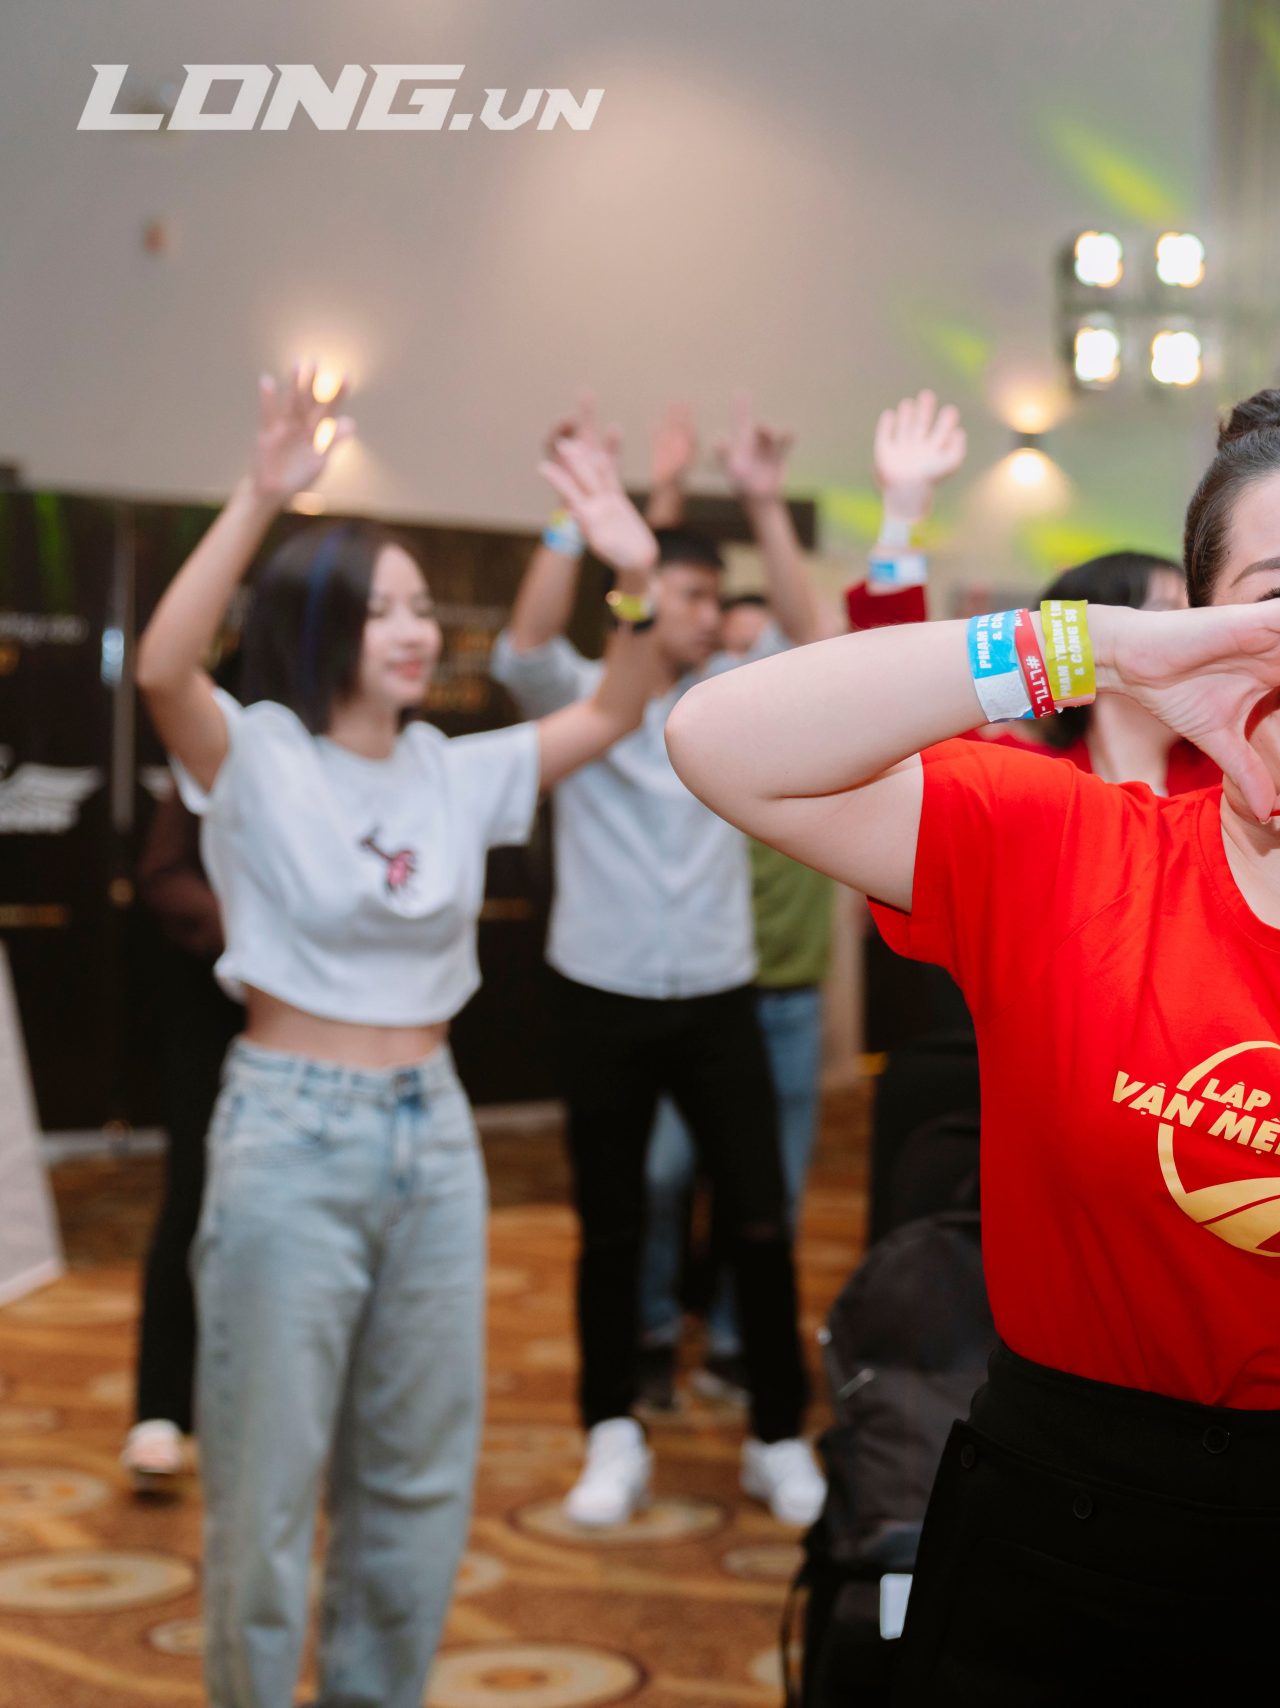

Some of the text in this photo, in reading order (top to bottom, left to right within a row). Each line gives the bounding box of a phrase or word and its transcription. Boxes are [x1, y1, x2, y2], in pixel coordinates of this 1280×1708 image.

[1025, 655, 1050, 705] #LTTL
[1112, 1070, 1205, 1128] VẬN
[1201, 1077, 1271, 1111] LẬP
